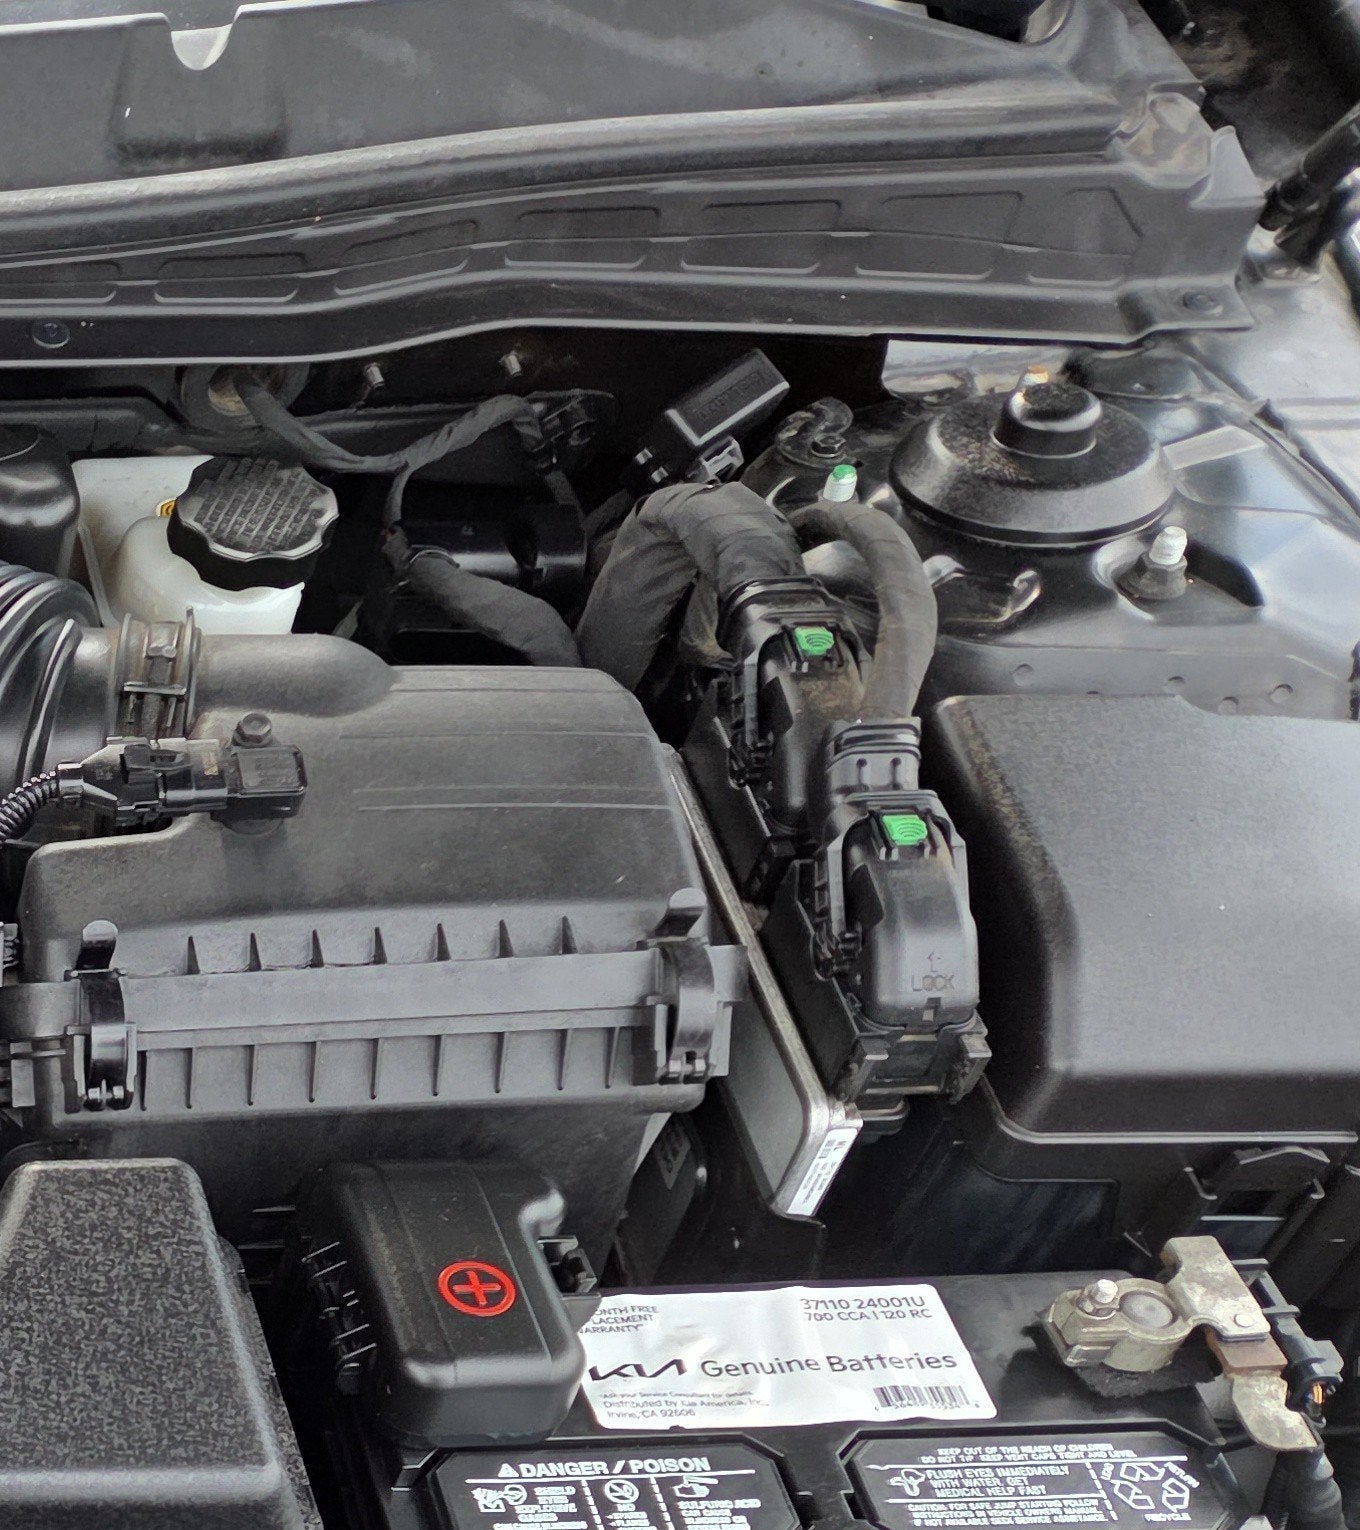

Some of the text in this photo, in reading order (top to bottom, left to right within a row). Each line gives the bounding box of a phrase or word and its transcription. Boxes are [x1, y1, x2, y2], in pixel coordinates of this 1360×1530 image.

[910, 974, 956, 992] LOCK
[800, 1295, 926, 1311] 37110 24001U
[596, 1305, 659, 1316] ONTH FREE
[805, 1311, 834, 1322] 700
[837, 1310, 870, 1322] CCA
[880, 1309, 906, 1320] 120
[911, 1307, 933, 1319] RC
[592, 1314, 654, 1325] LACEMENT
[580, 1323, 643, 1334] ARRANTY
[588, 1352, 958, 1382] KIA Genuine Batteries
[603, 1399, 662, 1409] Distributed
[664, 1399, 677, 1408] by
[642, 1409, 659, 1419] CA
[963, 1447, 983, 1455] OUT
[937, 1455, 957, 1464] NOT
[519, 1460, 608, 1478] DANGER
[630, 1456, 711, 1475] POISON
[925, 1465, 1070, 1480] FLUSH EYES IMMEDIATELY
[930, 1478, 961, 1489] WITH
[1006, 1476, 1029, 1487] GET
[934, 1484, 1047, 1498] MEDICAL HELP FAST
